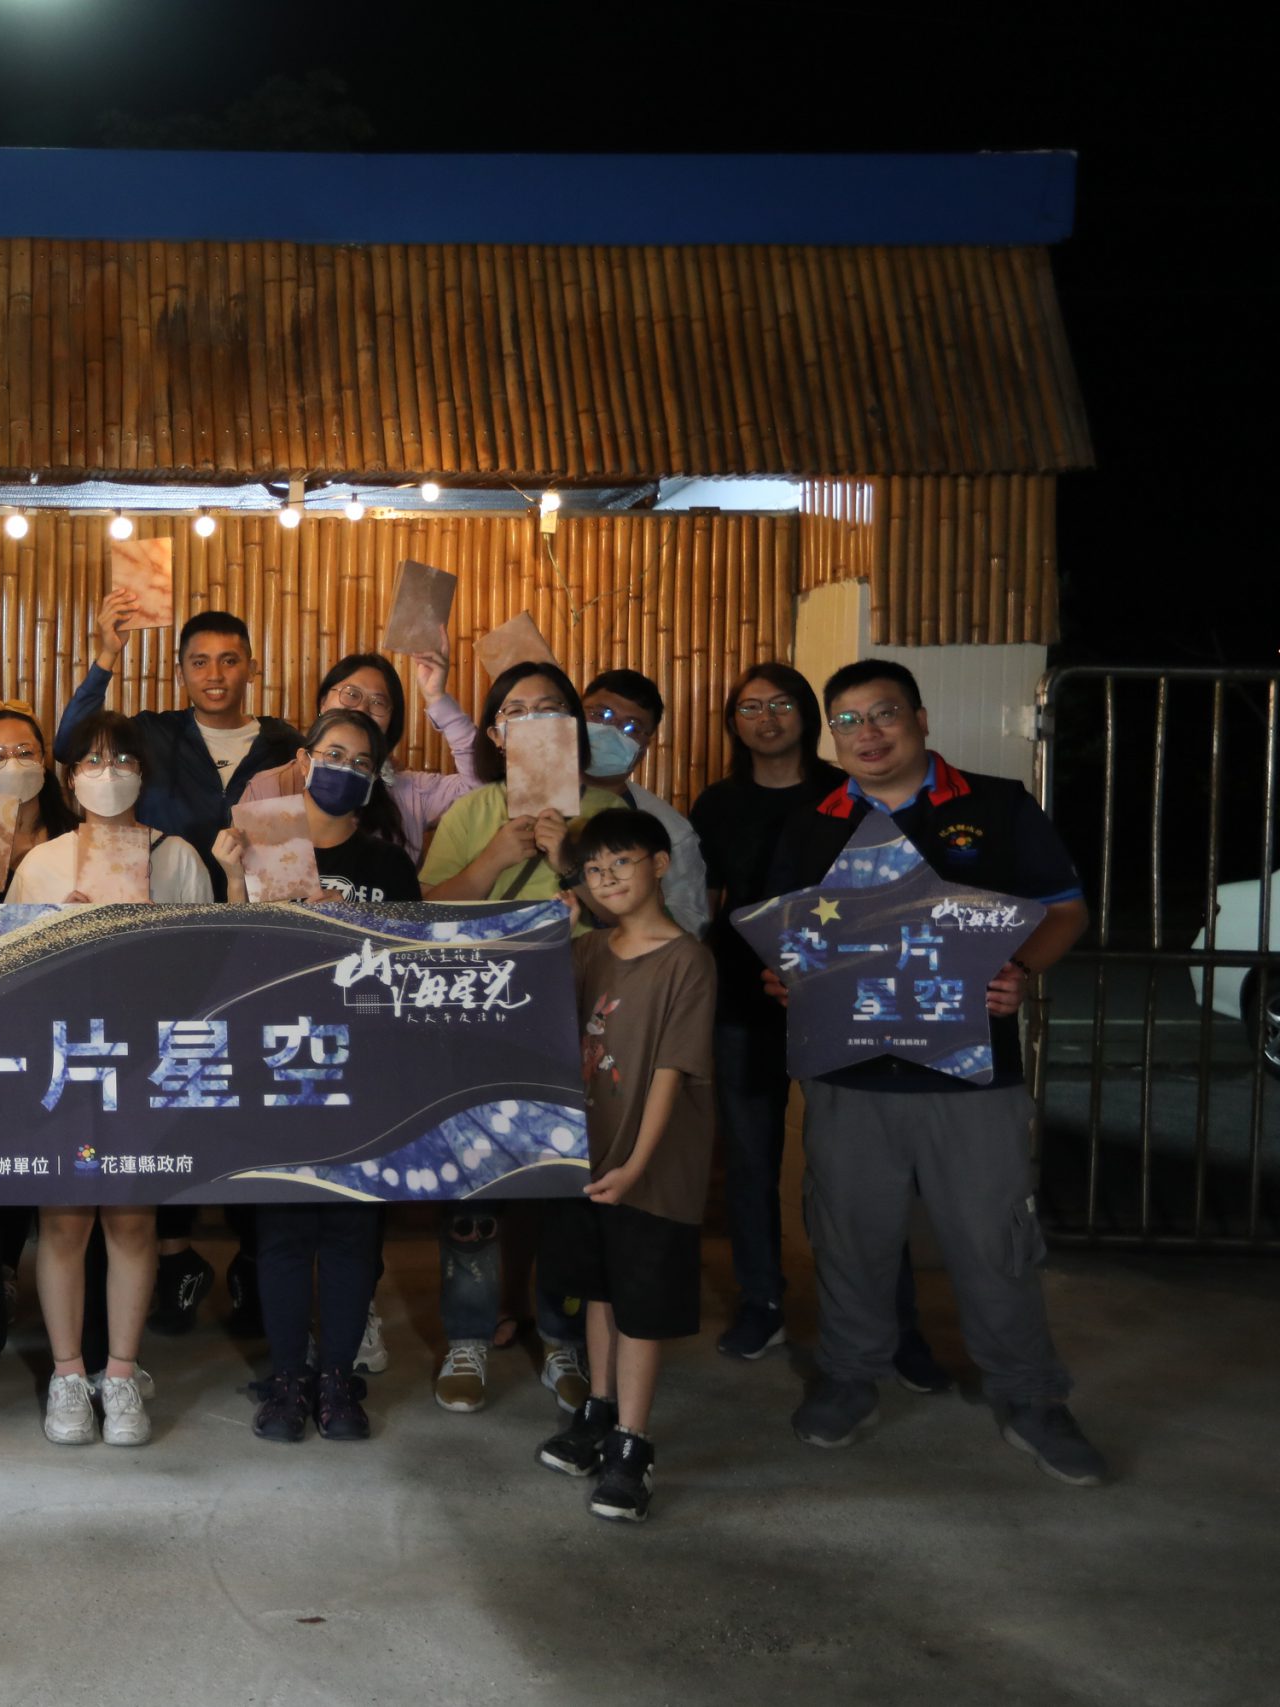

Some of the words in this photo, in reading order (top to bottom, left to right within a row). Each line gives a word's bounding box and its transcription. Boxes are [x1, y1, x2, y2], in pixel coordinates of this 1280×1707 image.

[779, 925, 944, 972] 染一片
[852, 976, 966, 1022] 星空
[100, 1154, 194, 1175] 花蓮縣政府
